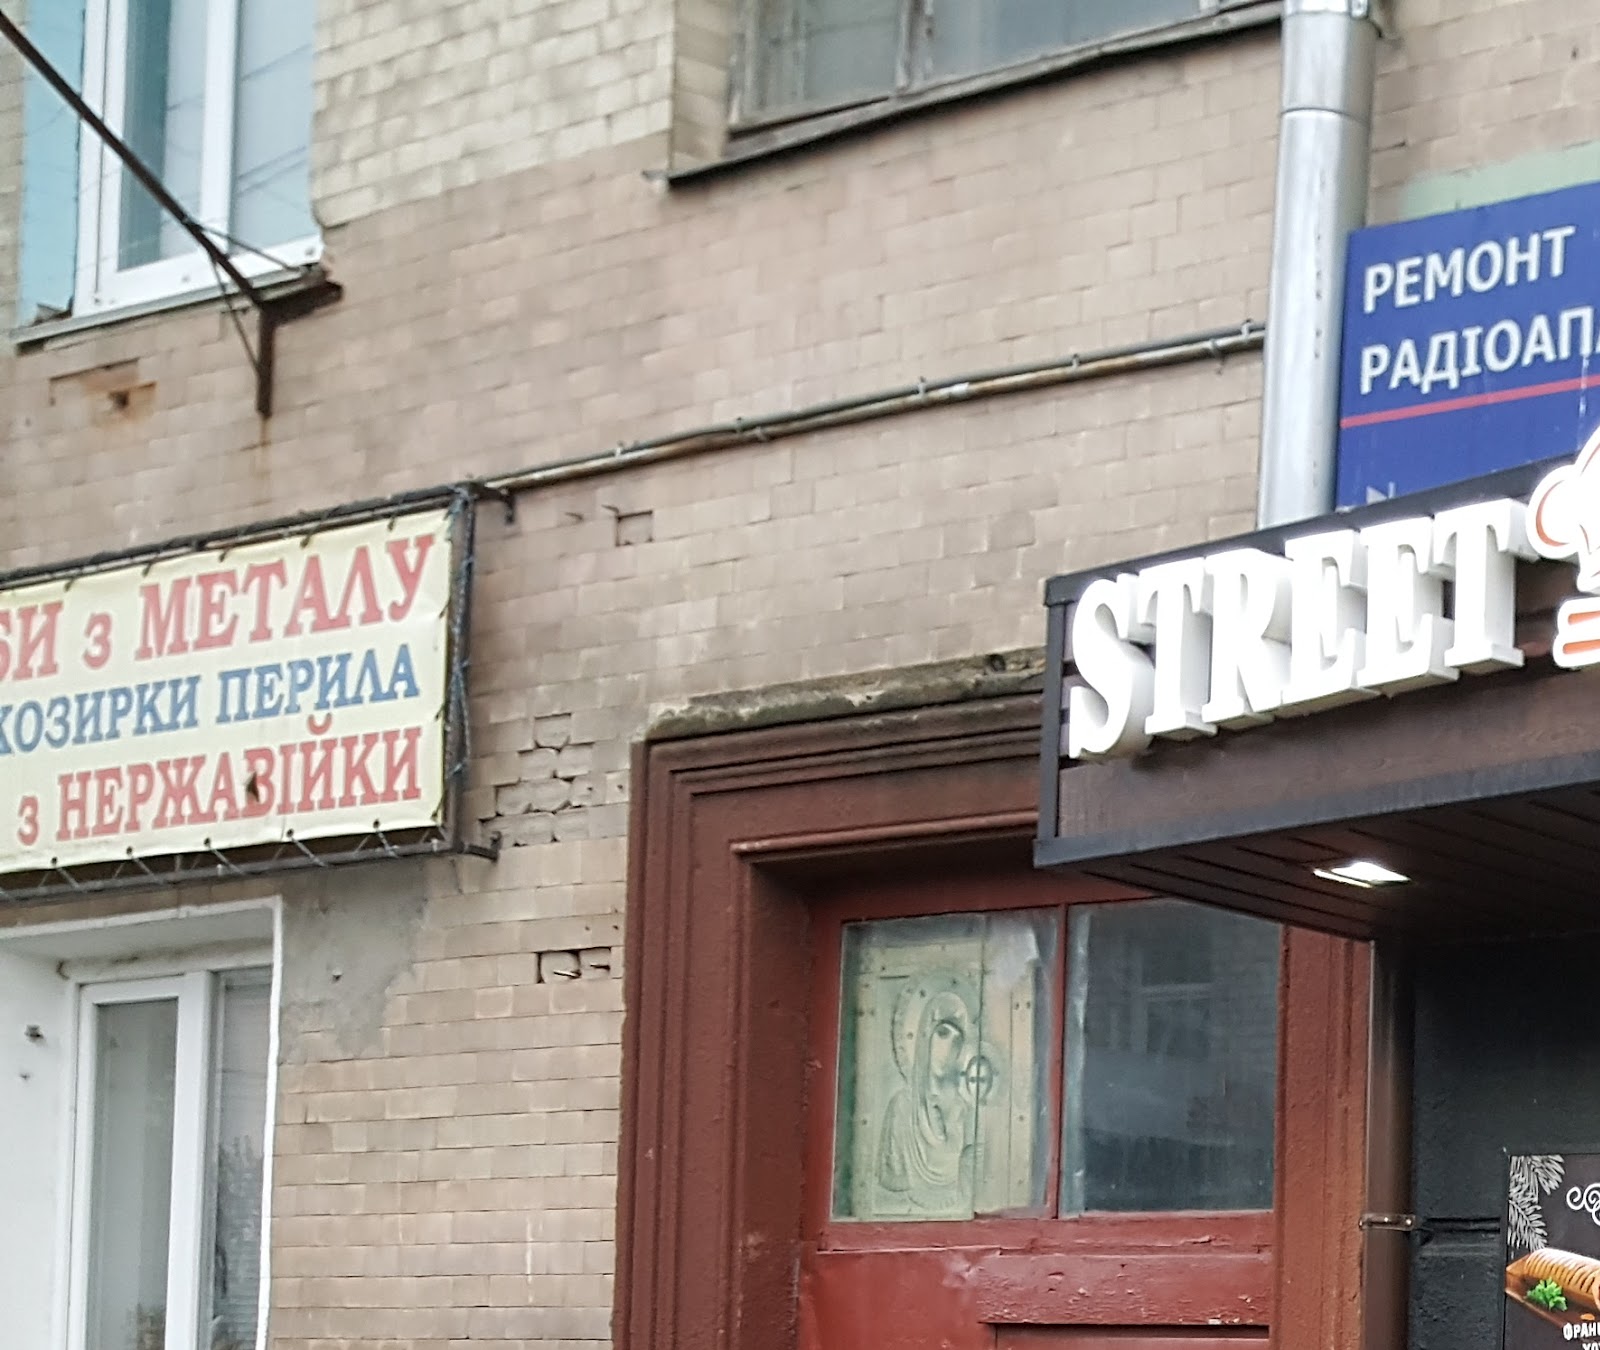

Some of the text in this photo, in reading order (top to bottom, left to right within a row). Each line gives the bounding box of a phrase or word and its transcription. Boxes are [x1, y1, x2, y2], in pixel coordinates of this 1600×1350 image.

[1363, 225, 1576, 313] РЕМОНТ
[83, 534, 436, 669] з МЕТАЛУ
[1066, 497, 1525, 760] STREET
[216, 643, 419, 724] ПЕРИЛА
[18, 712, 422, 845] з НЕРЖАВІЙКИ
